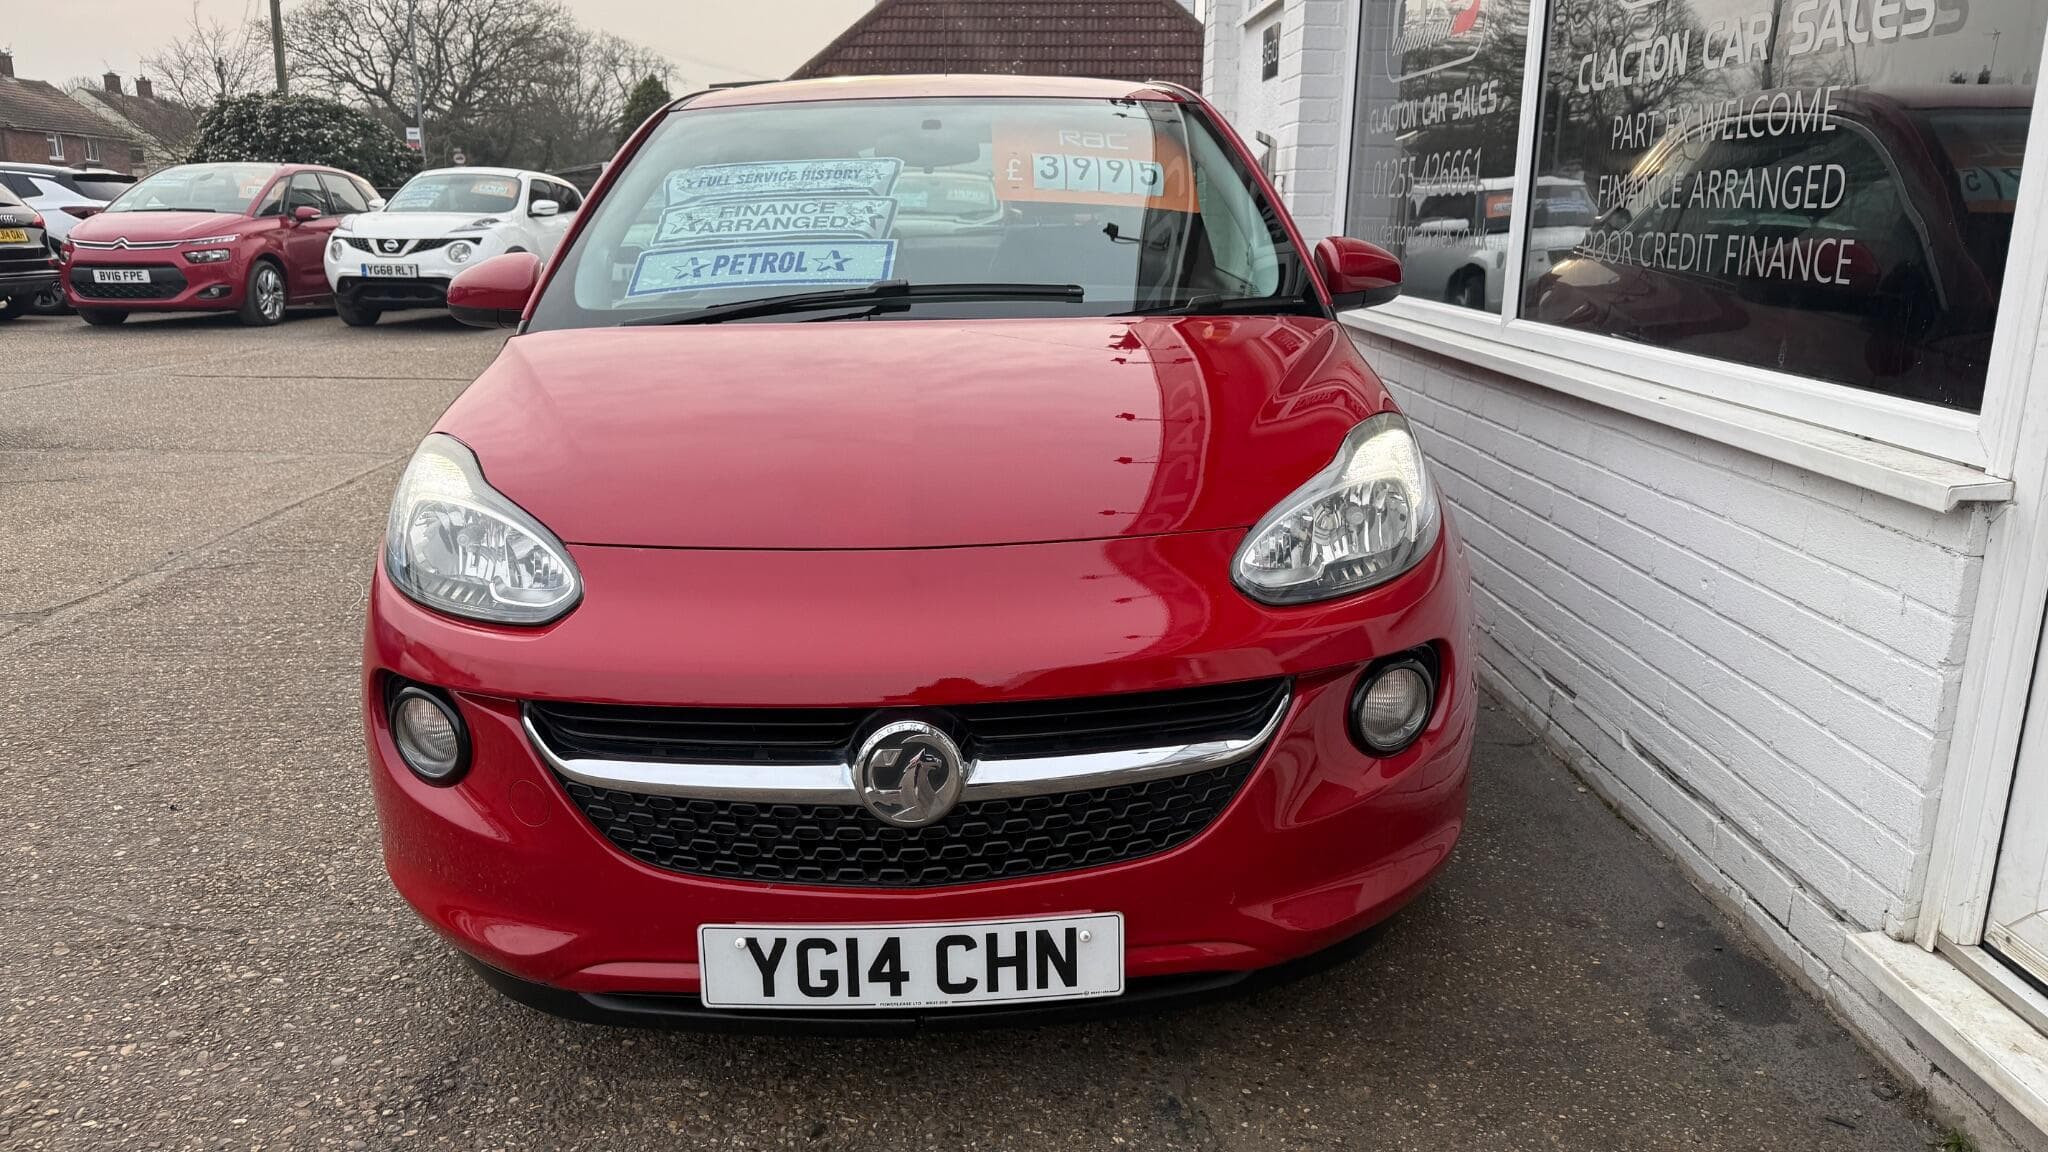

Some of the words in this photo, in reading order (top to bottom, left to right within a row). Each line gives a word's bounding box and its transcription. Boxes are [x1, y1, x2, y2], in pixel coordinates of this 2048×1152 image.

[1263, 39, 1278, 67] 360
[1578, 29, 1689, 93] CLACTON
[1703, 14, 1773, 69] CAR
[1788, 0, 1938, 55] SALES
[1369, 99, 1417, 134] CLACTON
[1422, 92, 1447, 125] CAR
[1452, 79, 1499, 120] SALES
[1611, 115, 1657, 150] PART
[1664, 108, 1692, 145] EX
[1696, 85, 1840, 142] WELCOME
[698, 175, 731, 188] FULL
[737, 170, 801, 184] SERVICE
[802, 168, 863, 182] HISTORY
[1039, 154, 1158, 186] 3995
[1372, 156, 1416, 199] 01255
[1420, 147, 1482, 197] 426661
[1597, 171, 1684, 209] FINANCE
[1688, 164, 1846, 209] ARRANGED
[696, 215, 849, 234] ARRANGED
[719, 202, 837, 218] FINANCE
[368, 263, 393, 277] YG68
[395, 264, 415, 278] RLT
[711, 250, 808, 276] PETROL
[1583, 230, 1633, 265] POOR
[1640, 231, 1719, 272] CREDIT
[1724, 234, 1856, 285] FINANCE
[99, 270, 121, 281] BV16
[123, 270, 143, 281] FPE
[746, 936, 910, 998] YG14
[936, 927, 1078, 995] CHN
